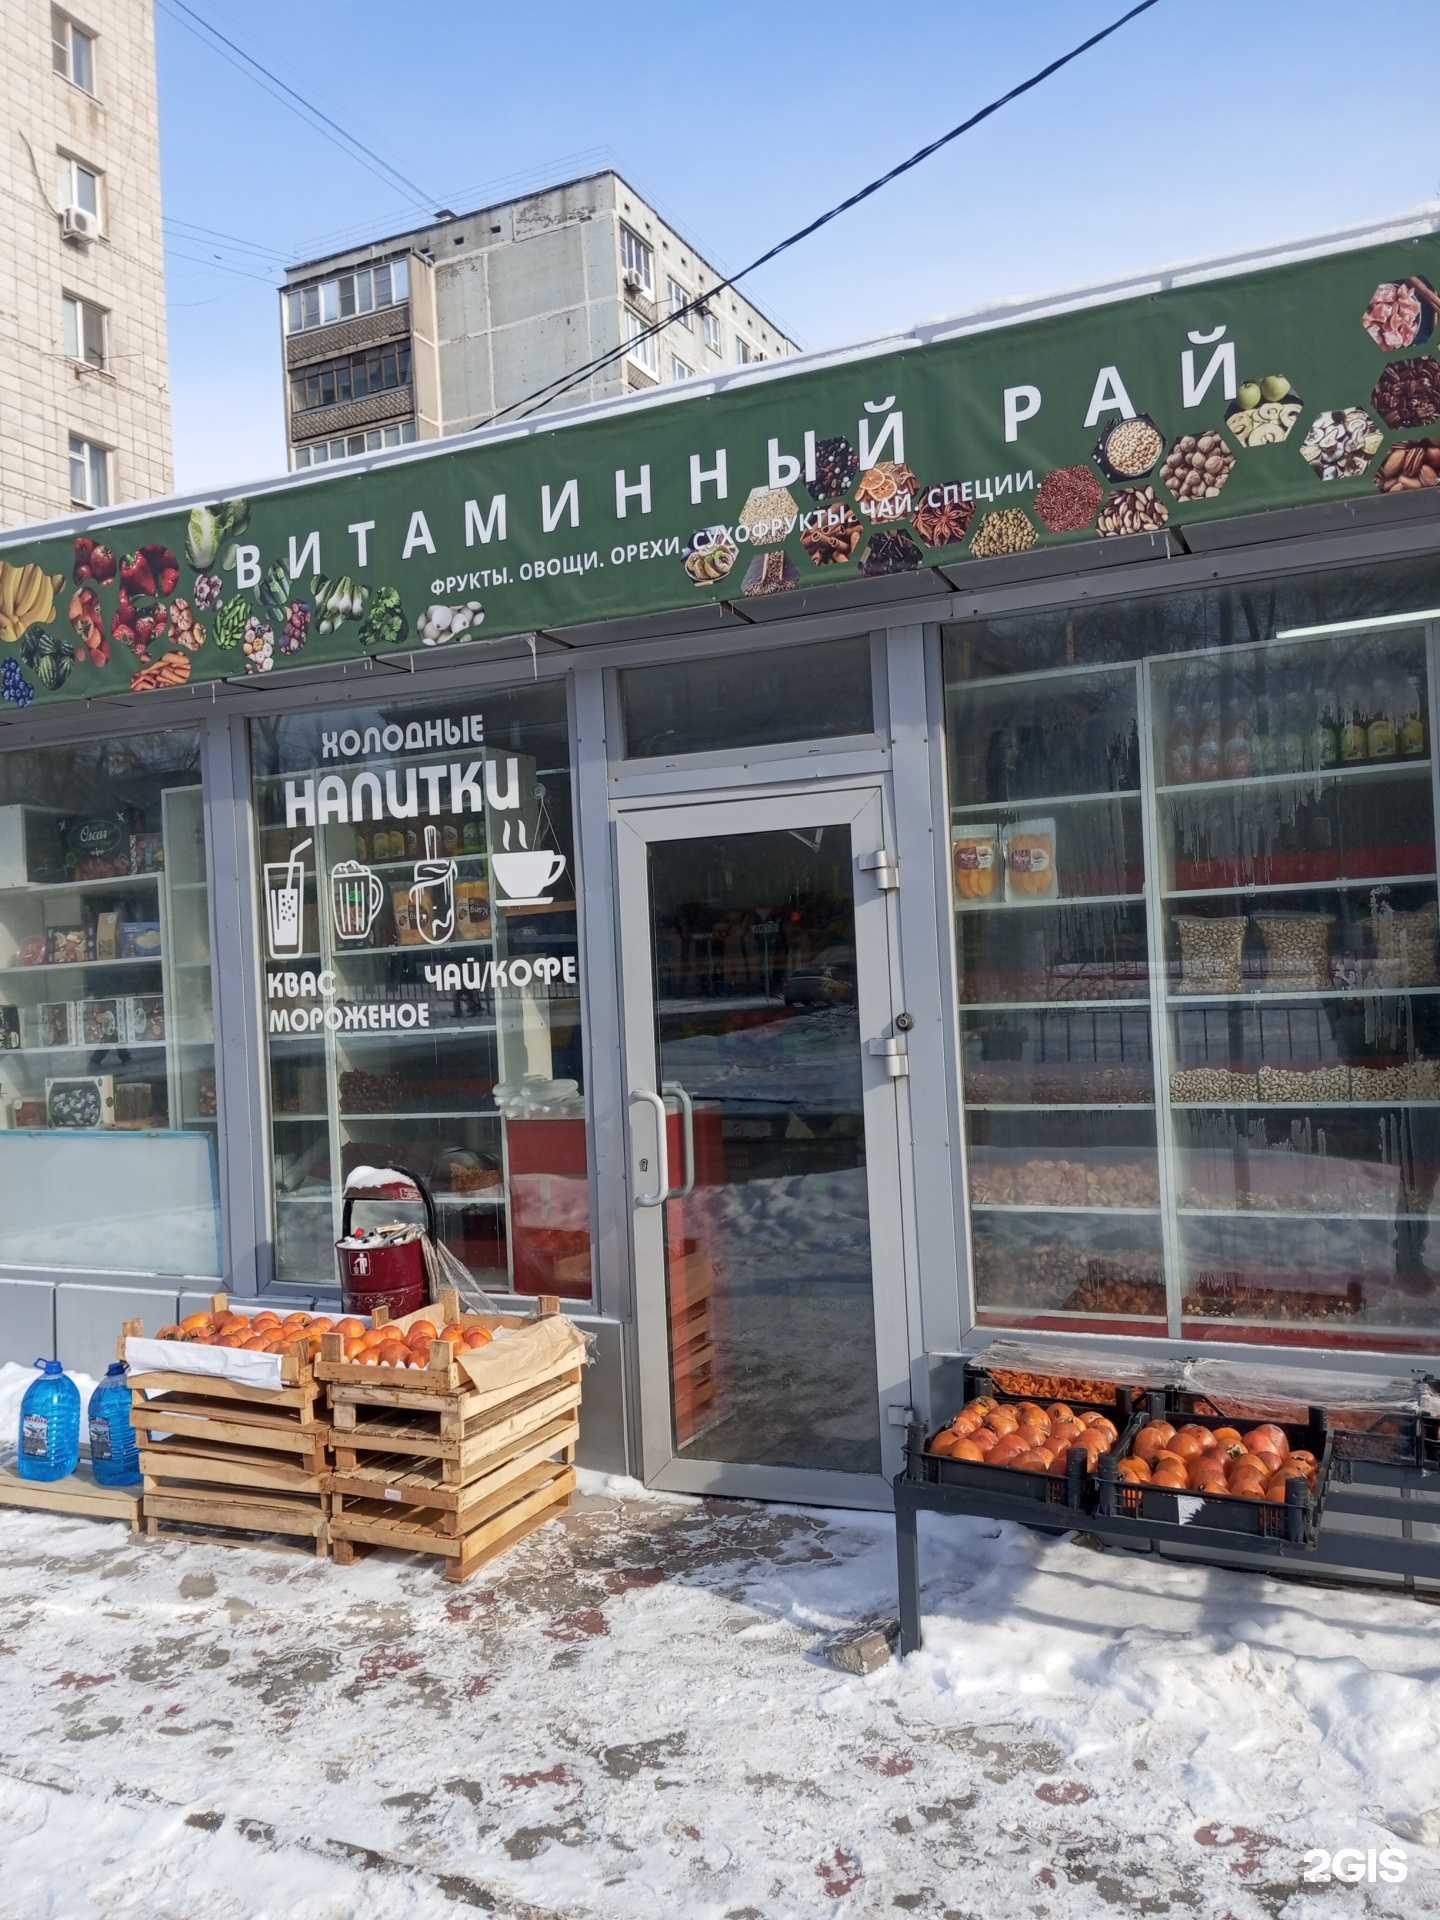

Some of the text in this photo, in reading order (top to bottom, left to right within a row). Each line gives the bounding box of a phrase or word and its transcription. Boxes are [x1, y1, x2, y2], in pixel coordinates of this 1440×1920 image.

[236, 325, 1237, 589] ВИТАМИННЫЙ РАЙ
[430, 470, 1042, 596] ФРУКТЫ. ОВОЩИ. ОРЕХИ. СУХОФРУКТЫ. ЧАЙ. СПЕЦИИ.
[322, 714, 483, 758] ХОЛОДНЫЕ
[285, 758, 520, 828] НАПИТКИ
[267, 970, 337, 998] КВАС
[424, 956, 577, 992] ЧАЙ/КОФЕ
[269, 1003, 430, 1032] МОРОЖЕНОЕ
